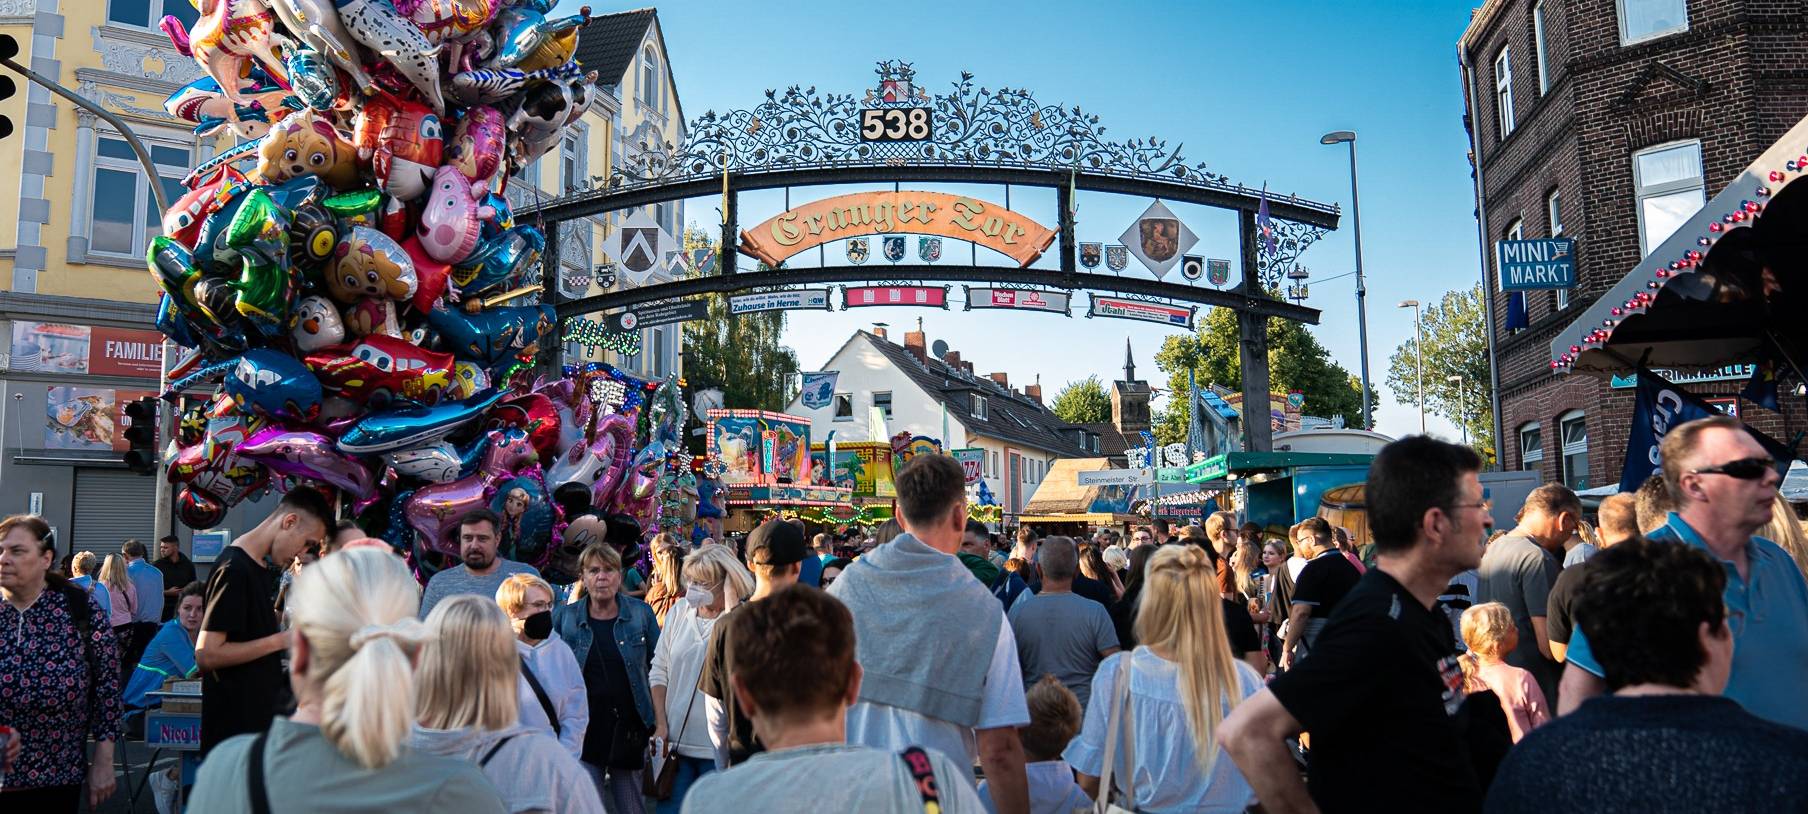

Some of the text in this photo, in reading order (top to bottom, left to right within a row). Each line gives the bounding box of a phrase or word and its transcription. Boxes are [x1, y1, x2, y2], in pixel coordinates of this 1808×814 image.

[862, 108, 929, 140] 538
[770, 196, 1026, 247] Cranger Tor
[1503, 241, 1549, 264] MINI
[1510, 264, 1569, 285] MARKT
[733, 299, 801, 312] Zuhause in Herne.
[1084, 475, 1125, 485] Steinmeister
[161, 724, 188, 745] Nico
